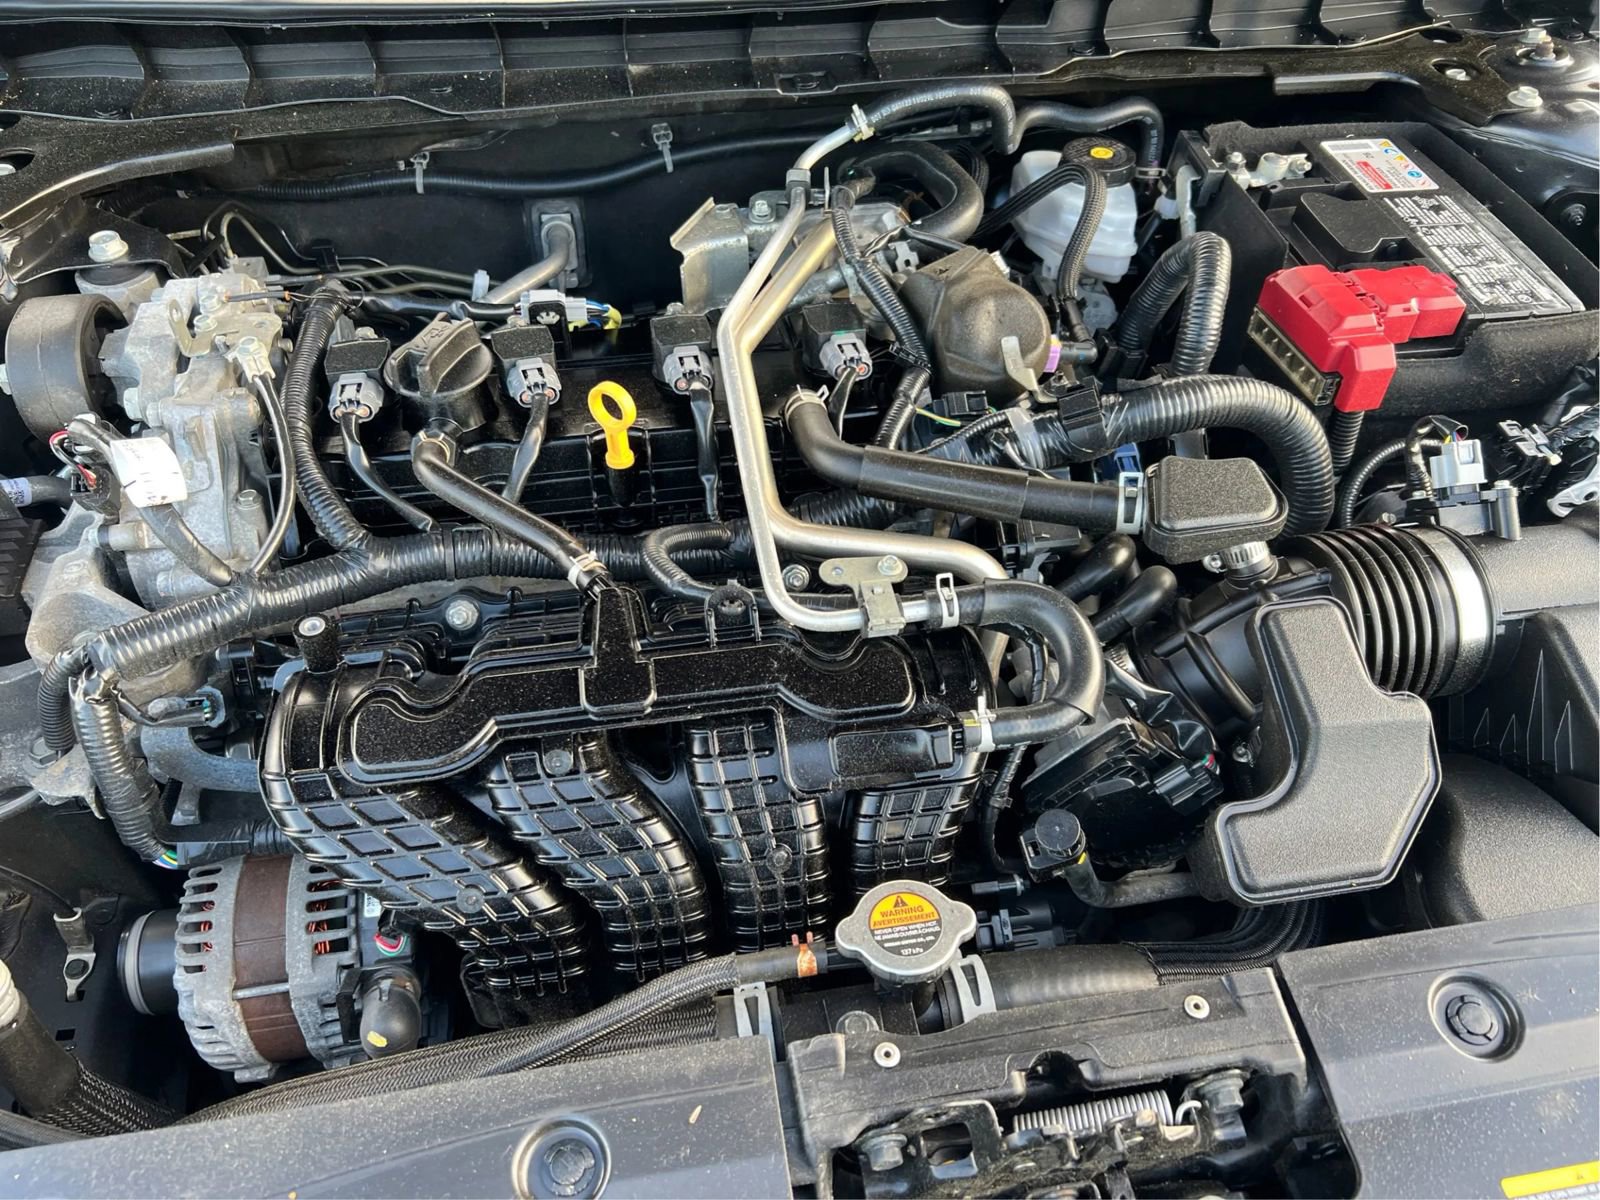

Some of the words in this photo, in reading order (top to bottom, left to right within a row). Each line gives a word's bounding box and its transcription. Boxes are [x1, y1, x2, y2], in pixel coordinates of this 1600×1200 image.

[880, 905, 924, 918] WARNING
[873, 912, 935, 927] AVERTISSEMENT
[901, 948, 912, 956] 137
